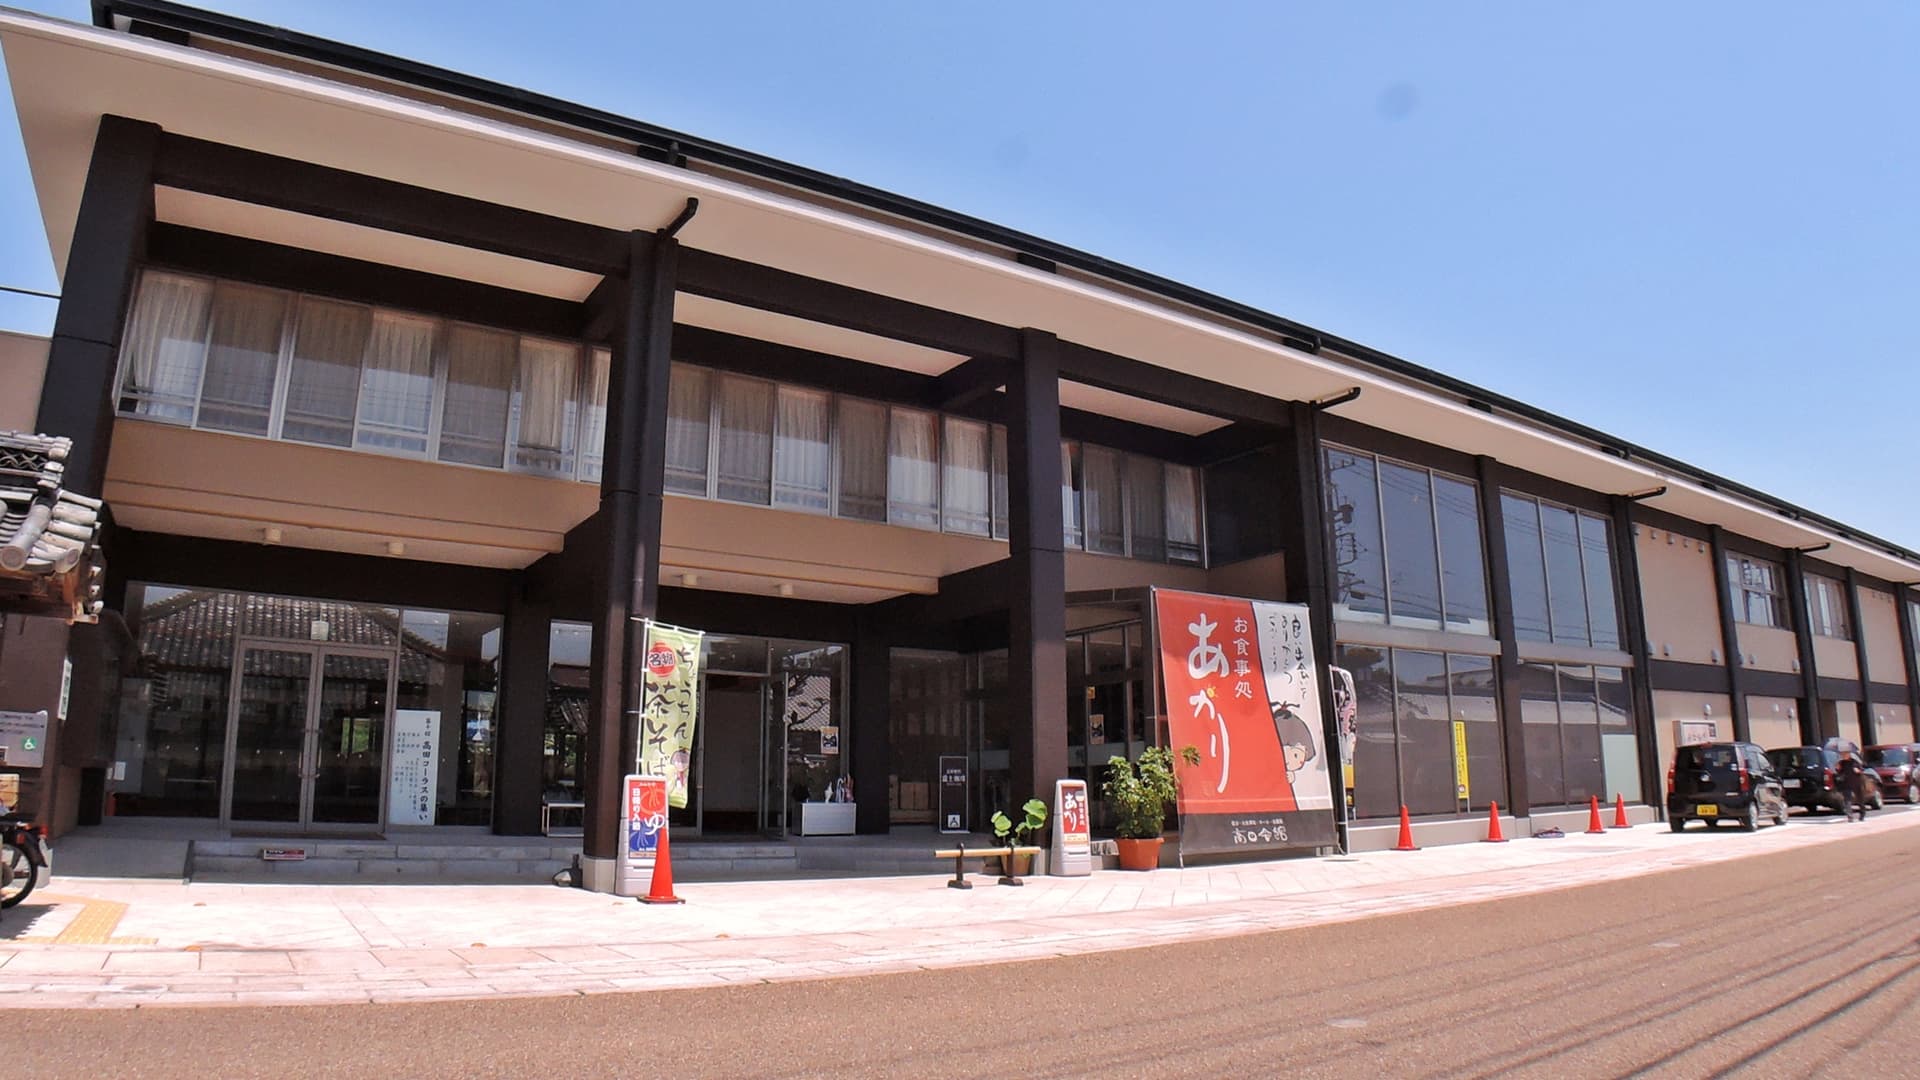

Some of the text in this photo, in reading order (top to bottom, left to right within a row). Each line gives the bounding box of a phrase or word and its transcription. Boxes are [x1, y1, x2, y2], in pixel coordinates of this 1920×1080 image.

[676, 646, 696, 740] ちょうちん
[1233, 616, 1252, 699] お食事処
[646, 680, 676, 776] 茶そば
[1188, 613, 1230, 793] あがり
[418, 741, 432, 821] 高田コーラスの集い
[1063, 792, 1078, 832] あがり
[643, 811, 665, 836] ゆ
